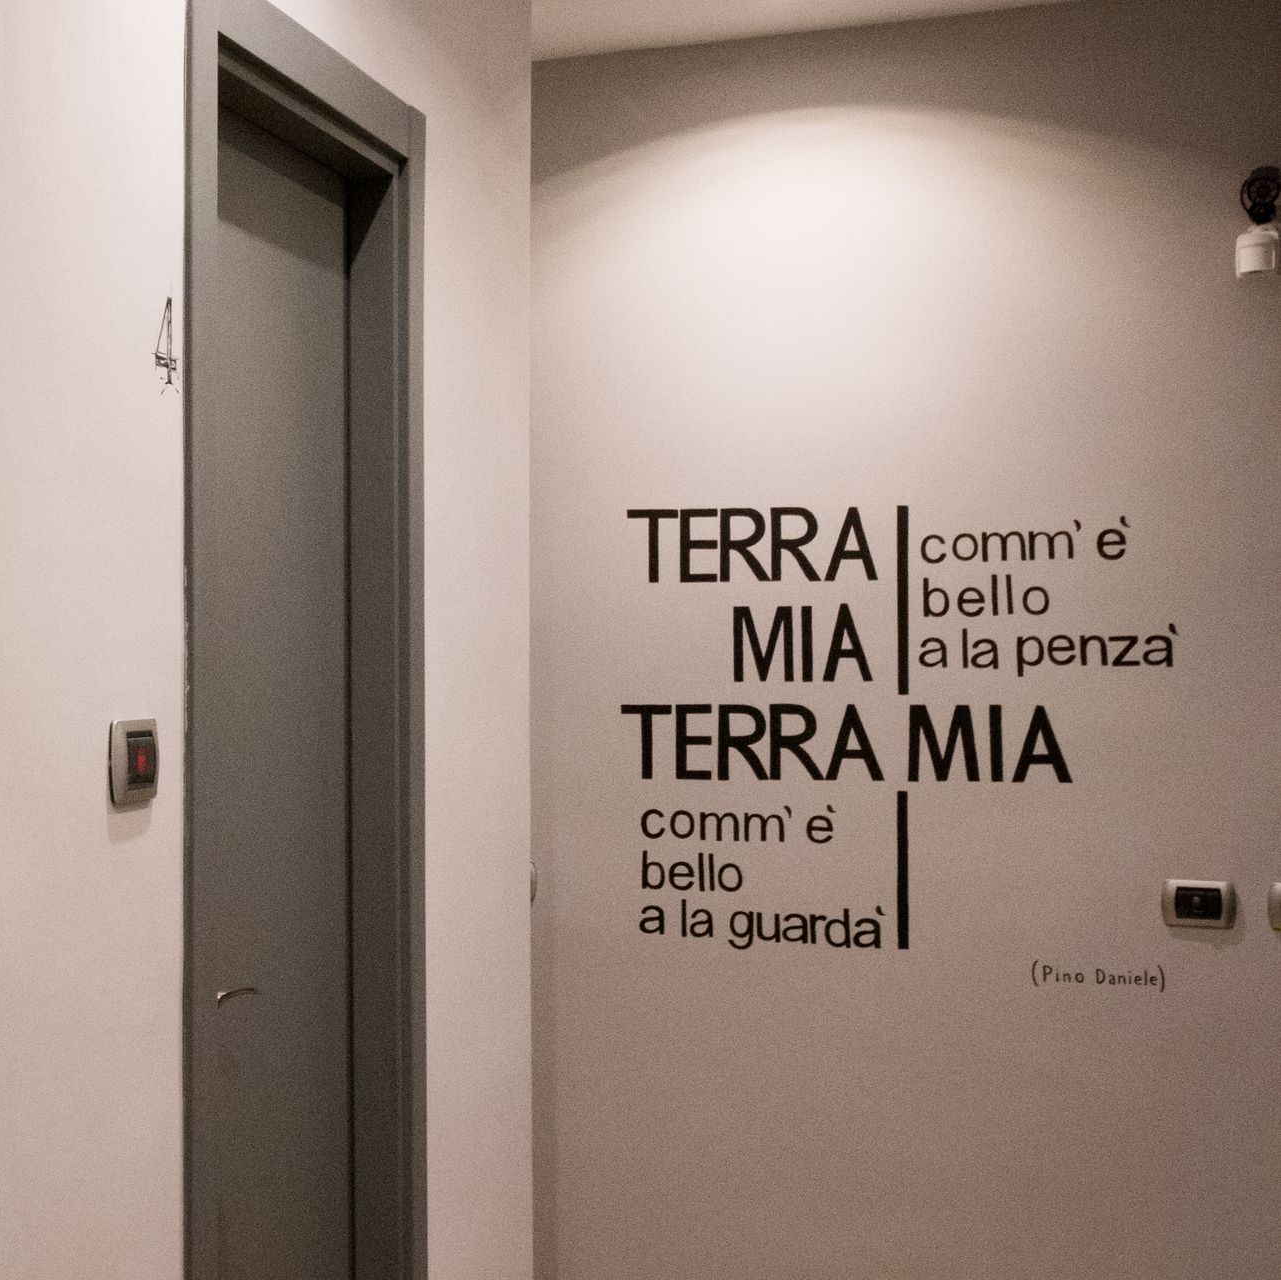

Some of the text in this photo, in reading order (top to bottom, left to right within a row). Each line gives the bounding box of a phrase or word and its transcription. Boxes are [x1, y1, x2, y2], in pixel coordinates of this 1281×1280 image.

[626, 506, 879, 584] TERRA
[922, 573, 1051, 618] bello
[732, 602, 874, 683] MIA
[918, 636, 948, 669] a
[961, 627, 1000, 670] la
[620, 703, 1074, 784] TERRA MIA
[641, 849, 744, 893] bello
[638, 904, 666, 936] a
[680, 898, 714, 939] la
[1030, 959, 1167, 994] (Pino Daniele)
